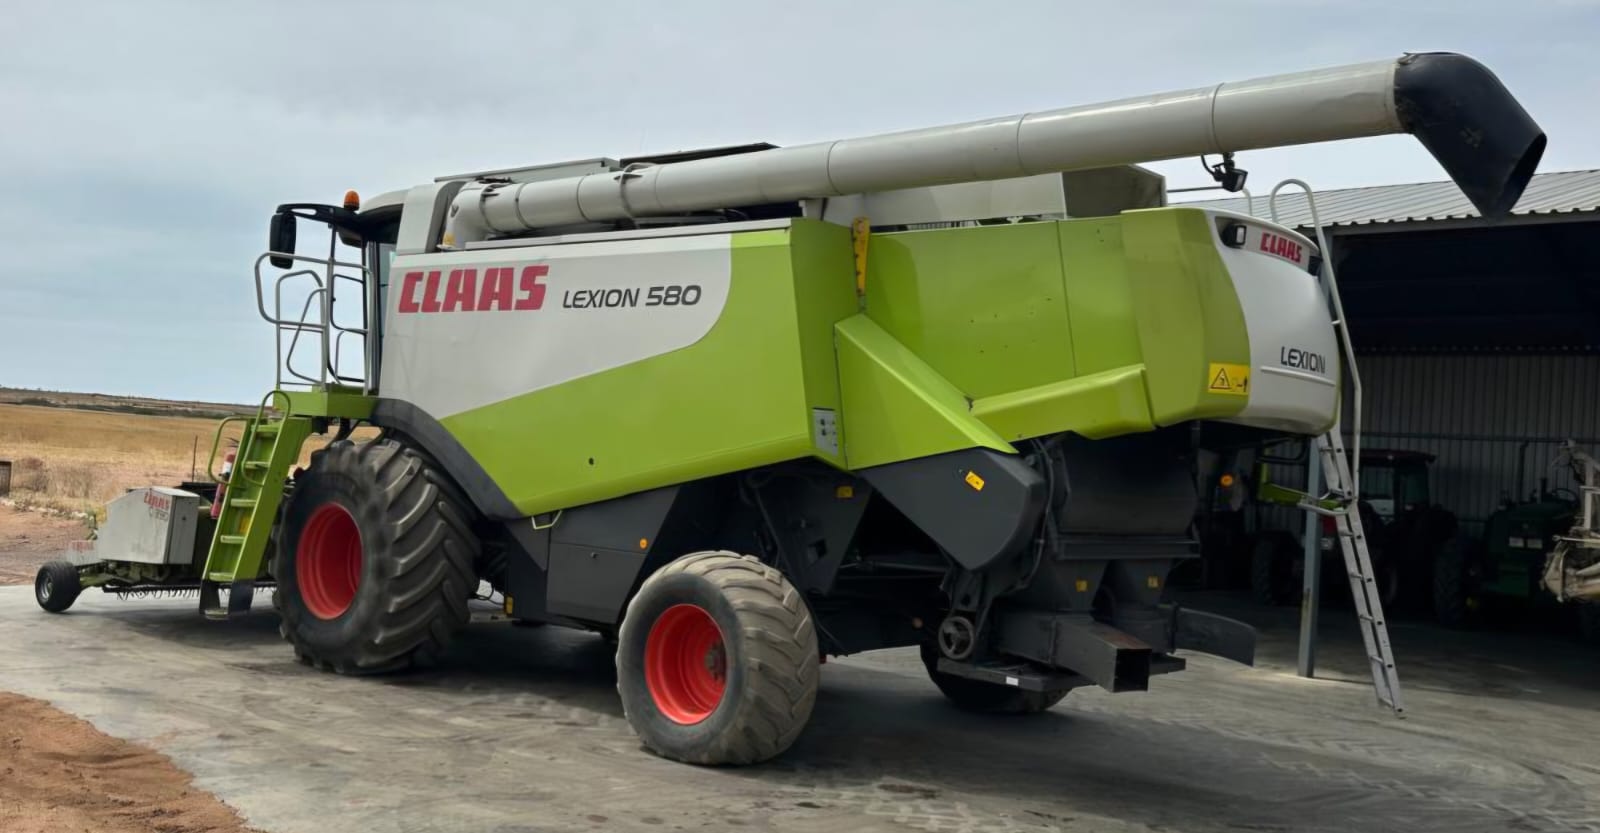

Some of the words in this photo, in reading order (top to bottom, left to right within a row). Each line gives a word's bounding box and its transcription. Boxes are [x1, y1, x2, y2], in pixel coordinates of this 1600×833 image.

[1260, 232, 1303, 263] CLAAS
[399, 265, 549, 313] CLAAS
[563, 288, 640, 309] LEXION
[646, 284, 702, 306] 580
[1281, 346, 1326, 374] LEXION
